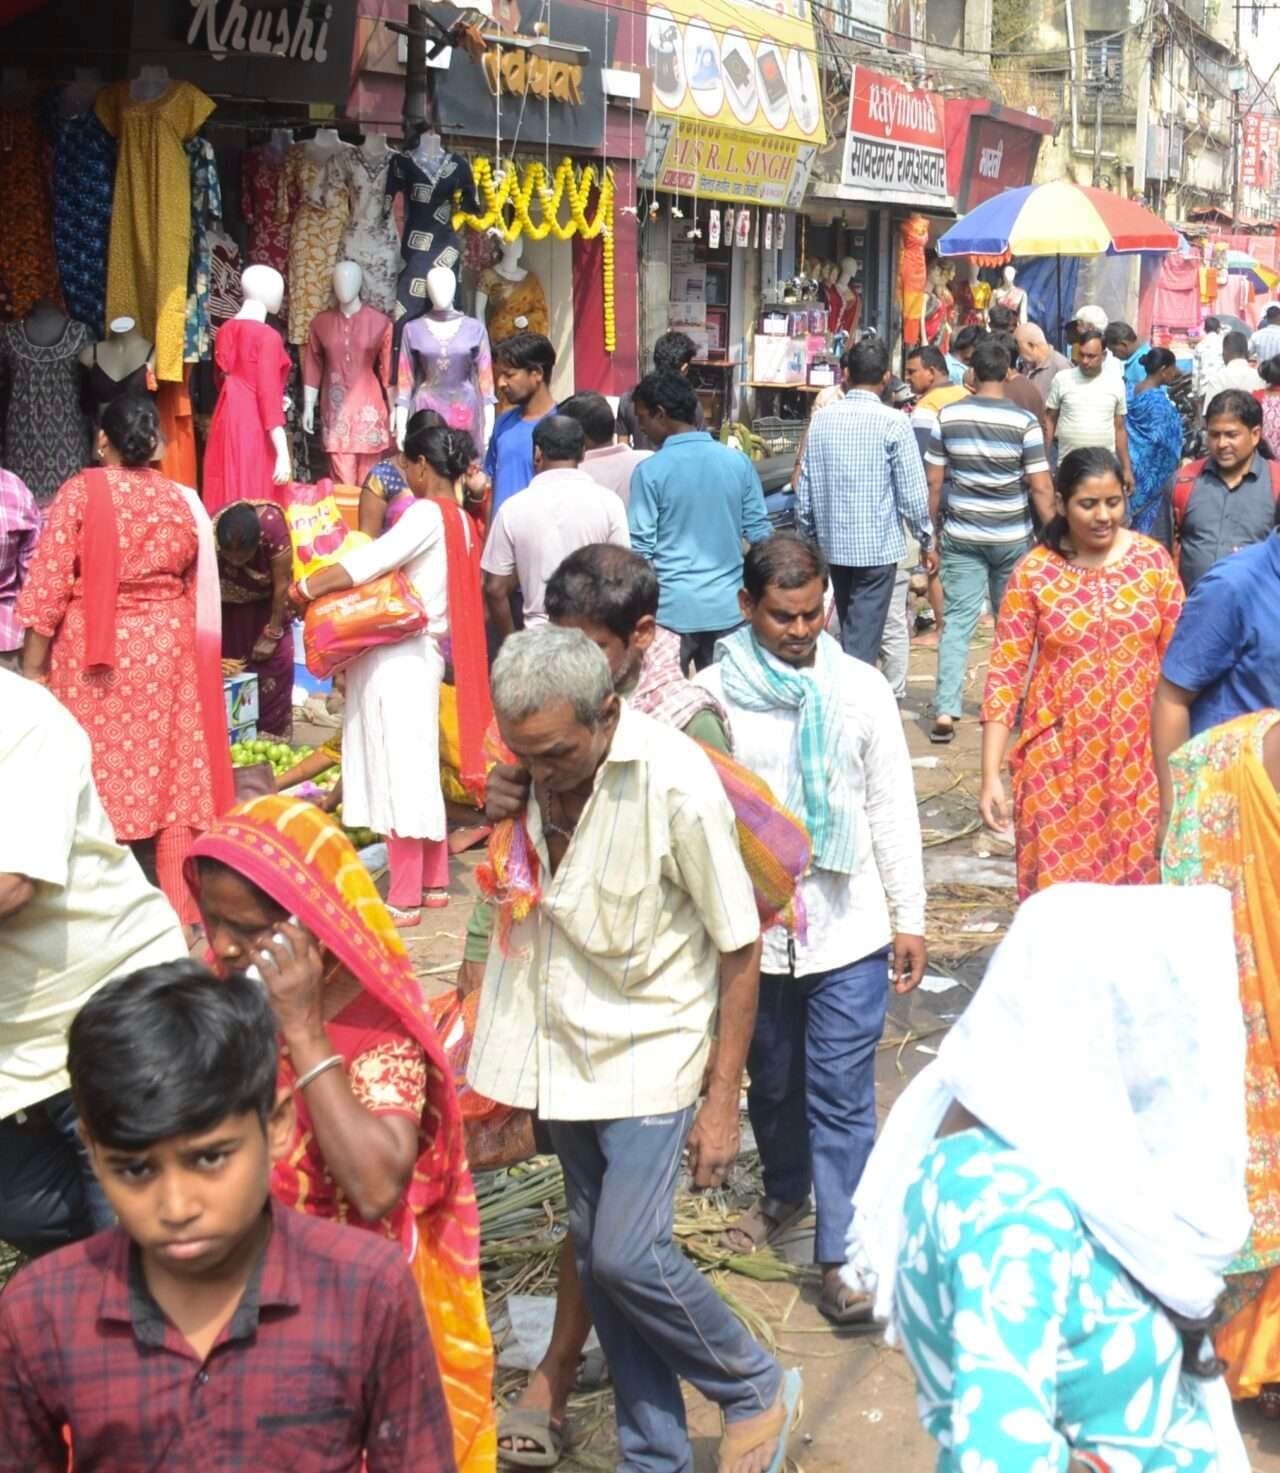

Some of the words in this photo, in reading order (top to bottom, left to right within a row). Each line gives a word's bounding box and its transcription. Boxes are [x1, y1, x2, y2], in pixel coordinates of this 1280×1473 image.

[187, 0, 333, 63] Khushi
[868, 83, 937, 137] Raymond
[743, 150, 793, 181] SINGH
